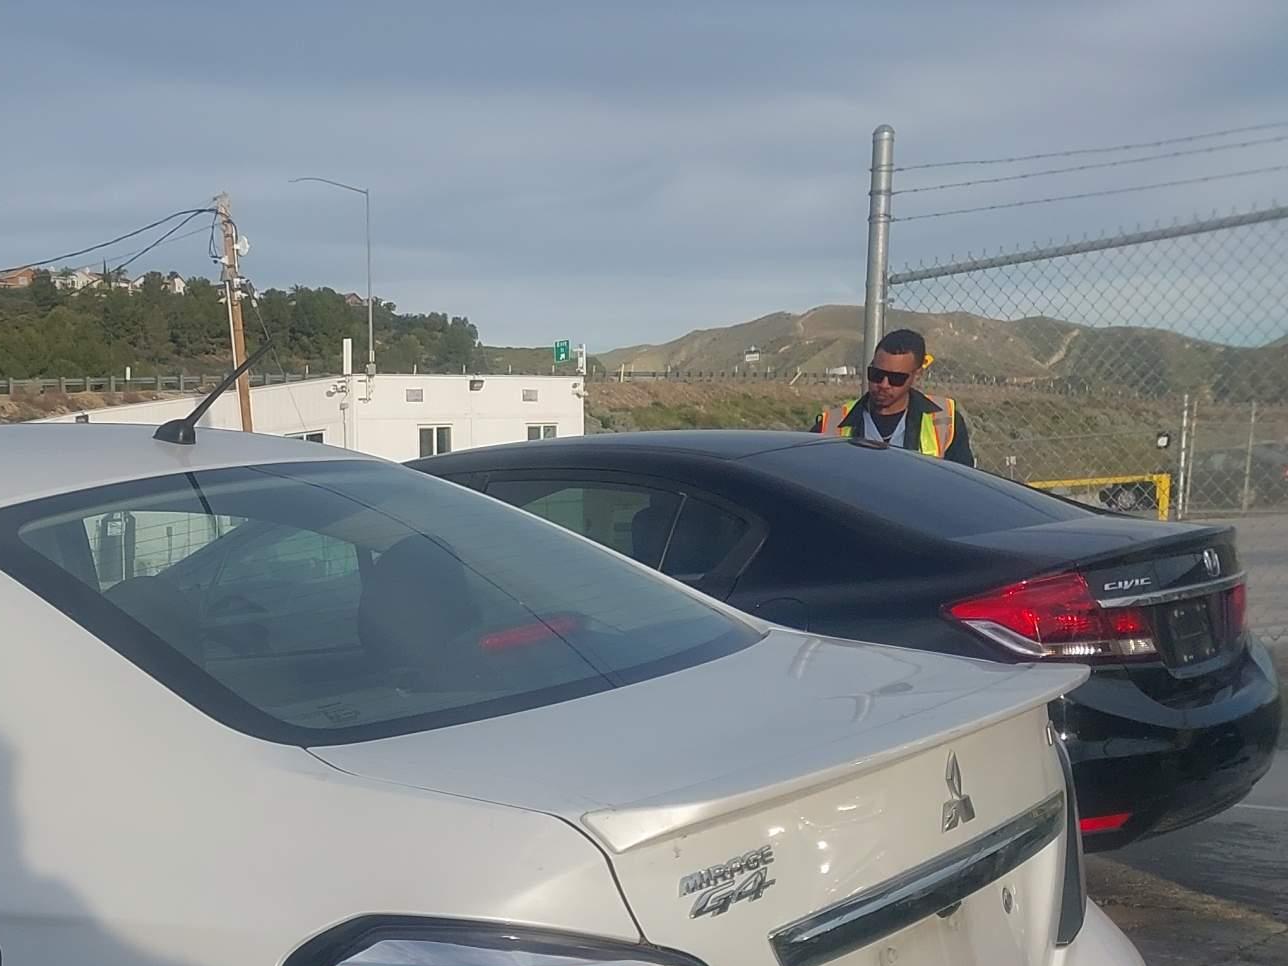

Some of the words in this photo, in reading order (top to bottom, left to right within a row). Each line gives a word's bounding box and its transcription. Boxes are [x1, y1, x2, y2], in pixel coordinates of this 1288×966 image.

[1103, 576, 1153, 592] CIVIC
[678, 844, 775, 898] MIRAGE
[688, 866, 777, 920] G4
